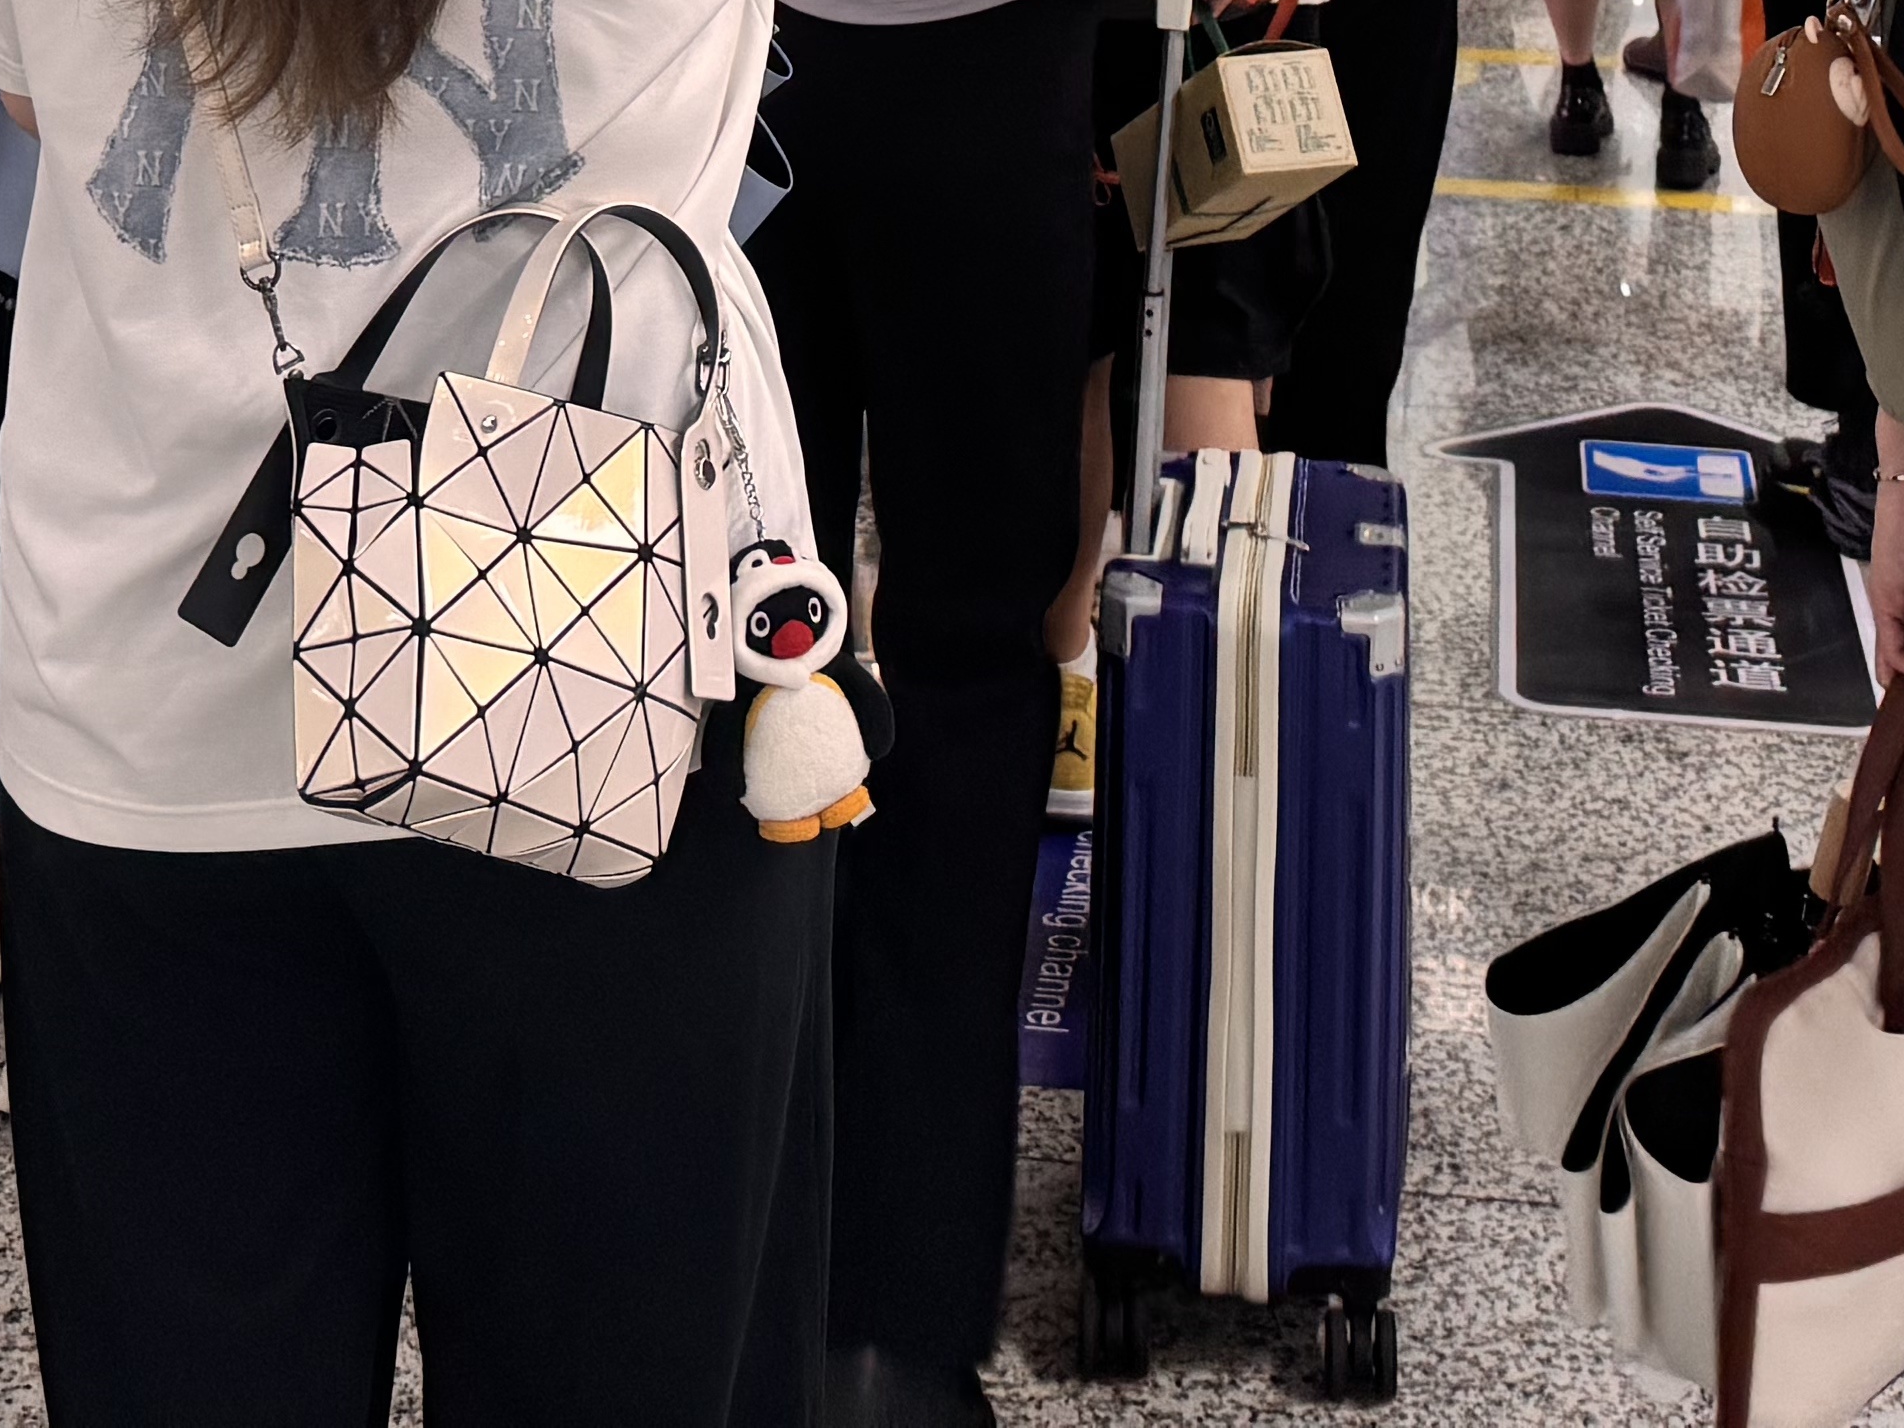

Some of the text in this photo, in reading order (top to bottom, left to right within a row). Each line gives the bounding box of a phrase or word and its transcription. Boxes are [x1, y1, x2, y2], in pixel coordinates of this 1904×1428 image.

[1694, 515, 1788, 692] 自助检票通道
[1024, 934, 1090, 1033] channel
